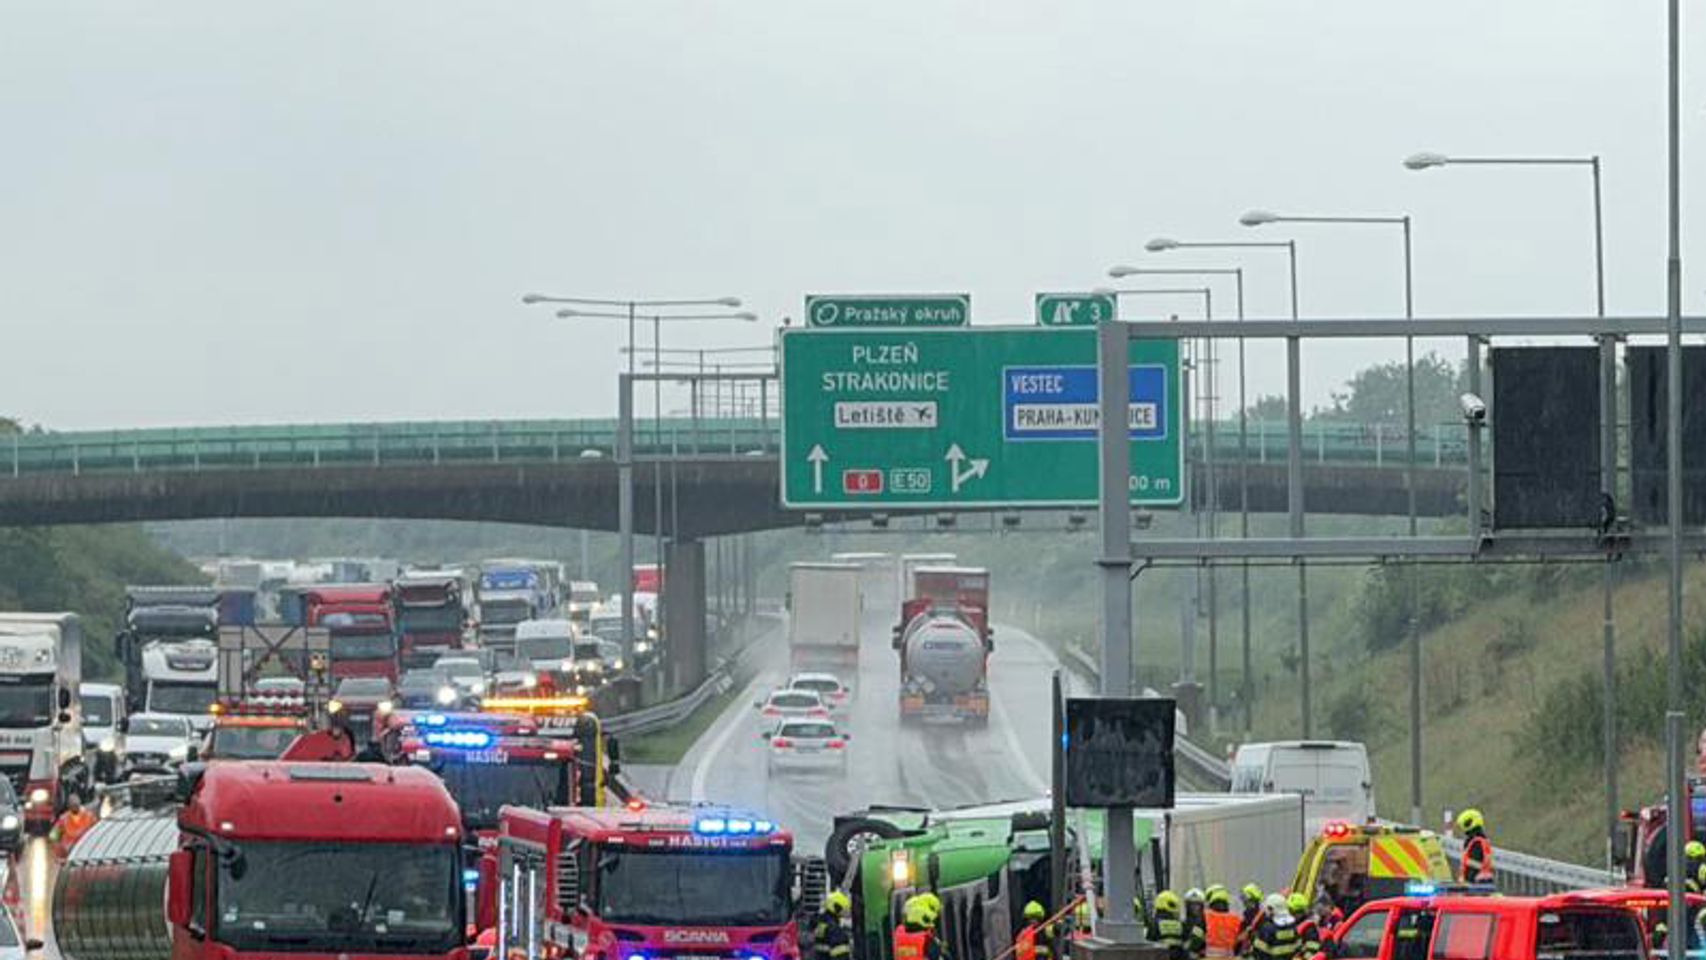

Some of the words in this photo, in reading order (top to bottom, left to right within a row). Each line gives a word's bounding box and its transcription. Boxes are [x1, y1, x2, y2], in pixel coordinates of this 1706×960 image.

[845, 306, 908, 324] Pražský
[915, 307, 960, 321] okruh
[1089, 302, 1101, 320] 3
[853, 342, 918, 364] PLZEŇ
[822, 371, 949, 391] STRAKONICE
[1011, 375, 1064, 393] VESTEC
[838, 406, 906, 424] Letiště
[664, 930, 729, 943] SCANIA
